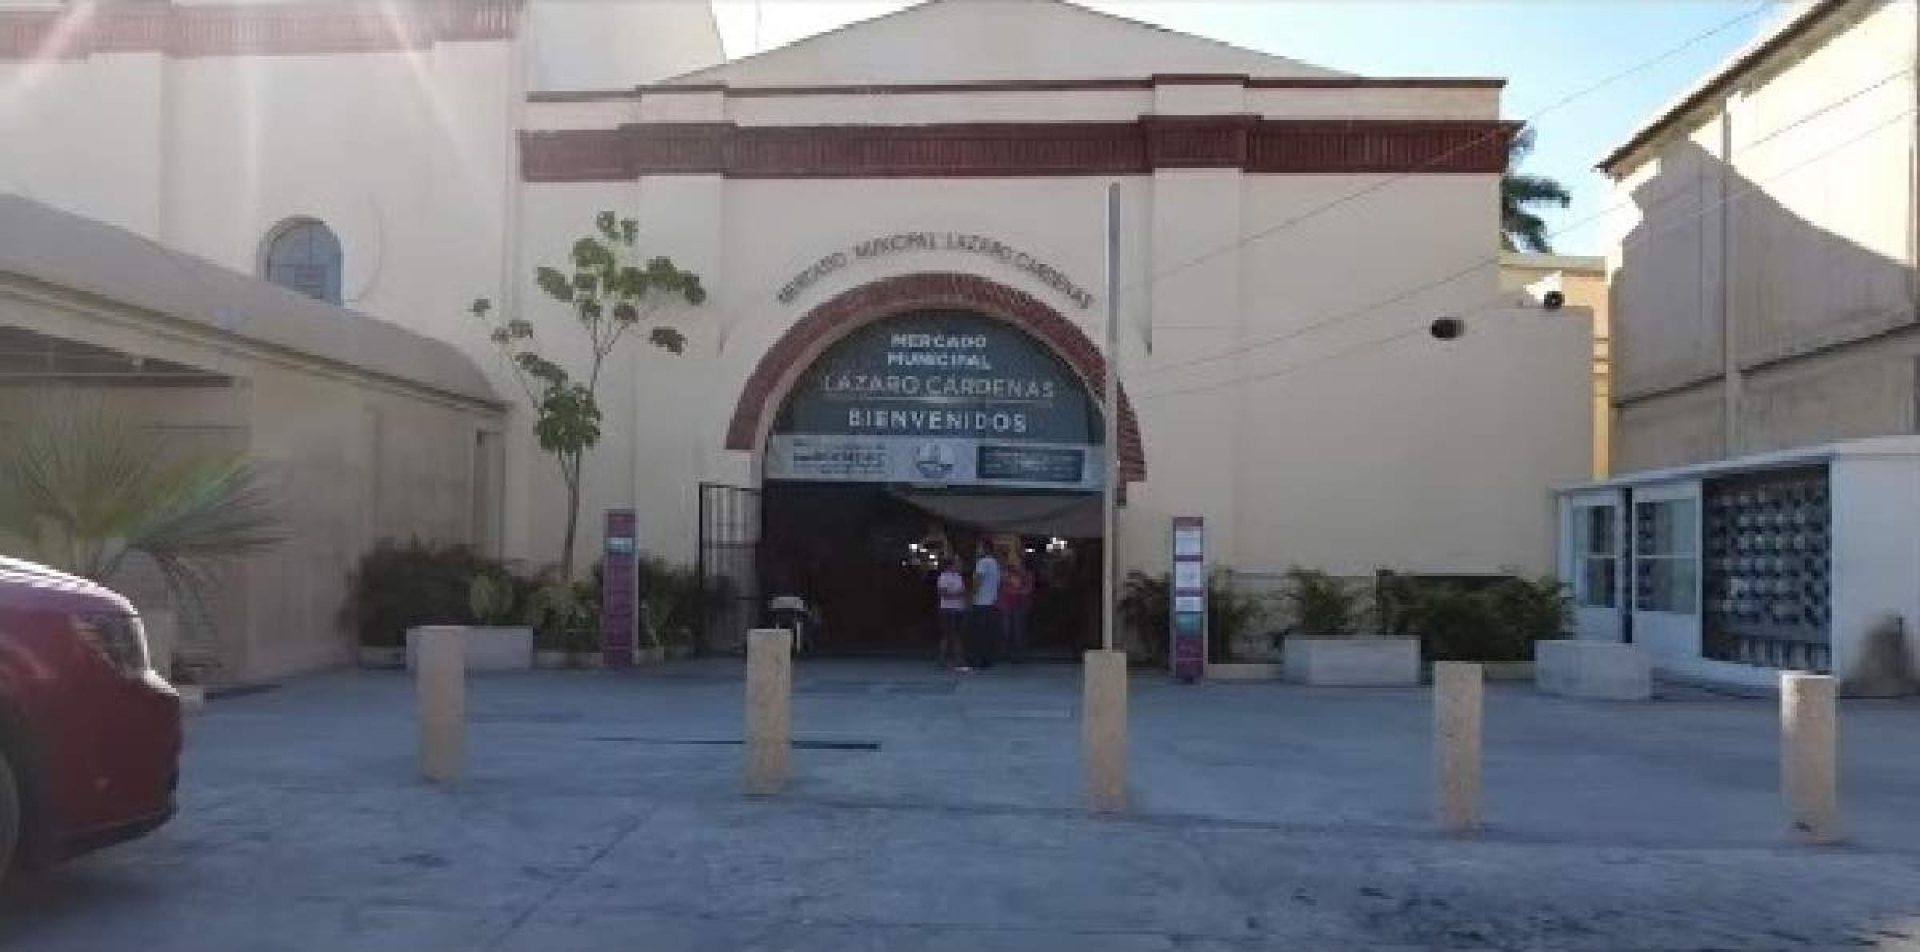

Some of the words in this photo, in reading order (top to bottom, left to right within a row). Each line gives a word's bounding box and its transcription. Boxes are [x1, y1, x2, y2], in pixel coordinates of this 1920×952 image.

[854, 231, 936, 257] MUNICIPAL
[890, 333, 986, 348] MERCADO
[887, 351, 991, 370] MUNICIPAL
[849, 409, 1027, 433] BIENVENIDOS
